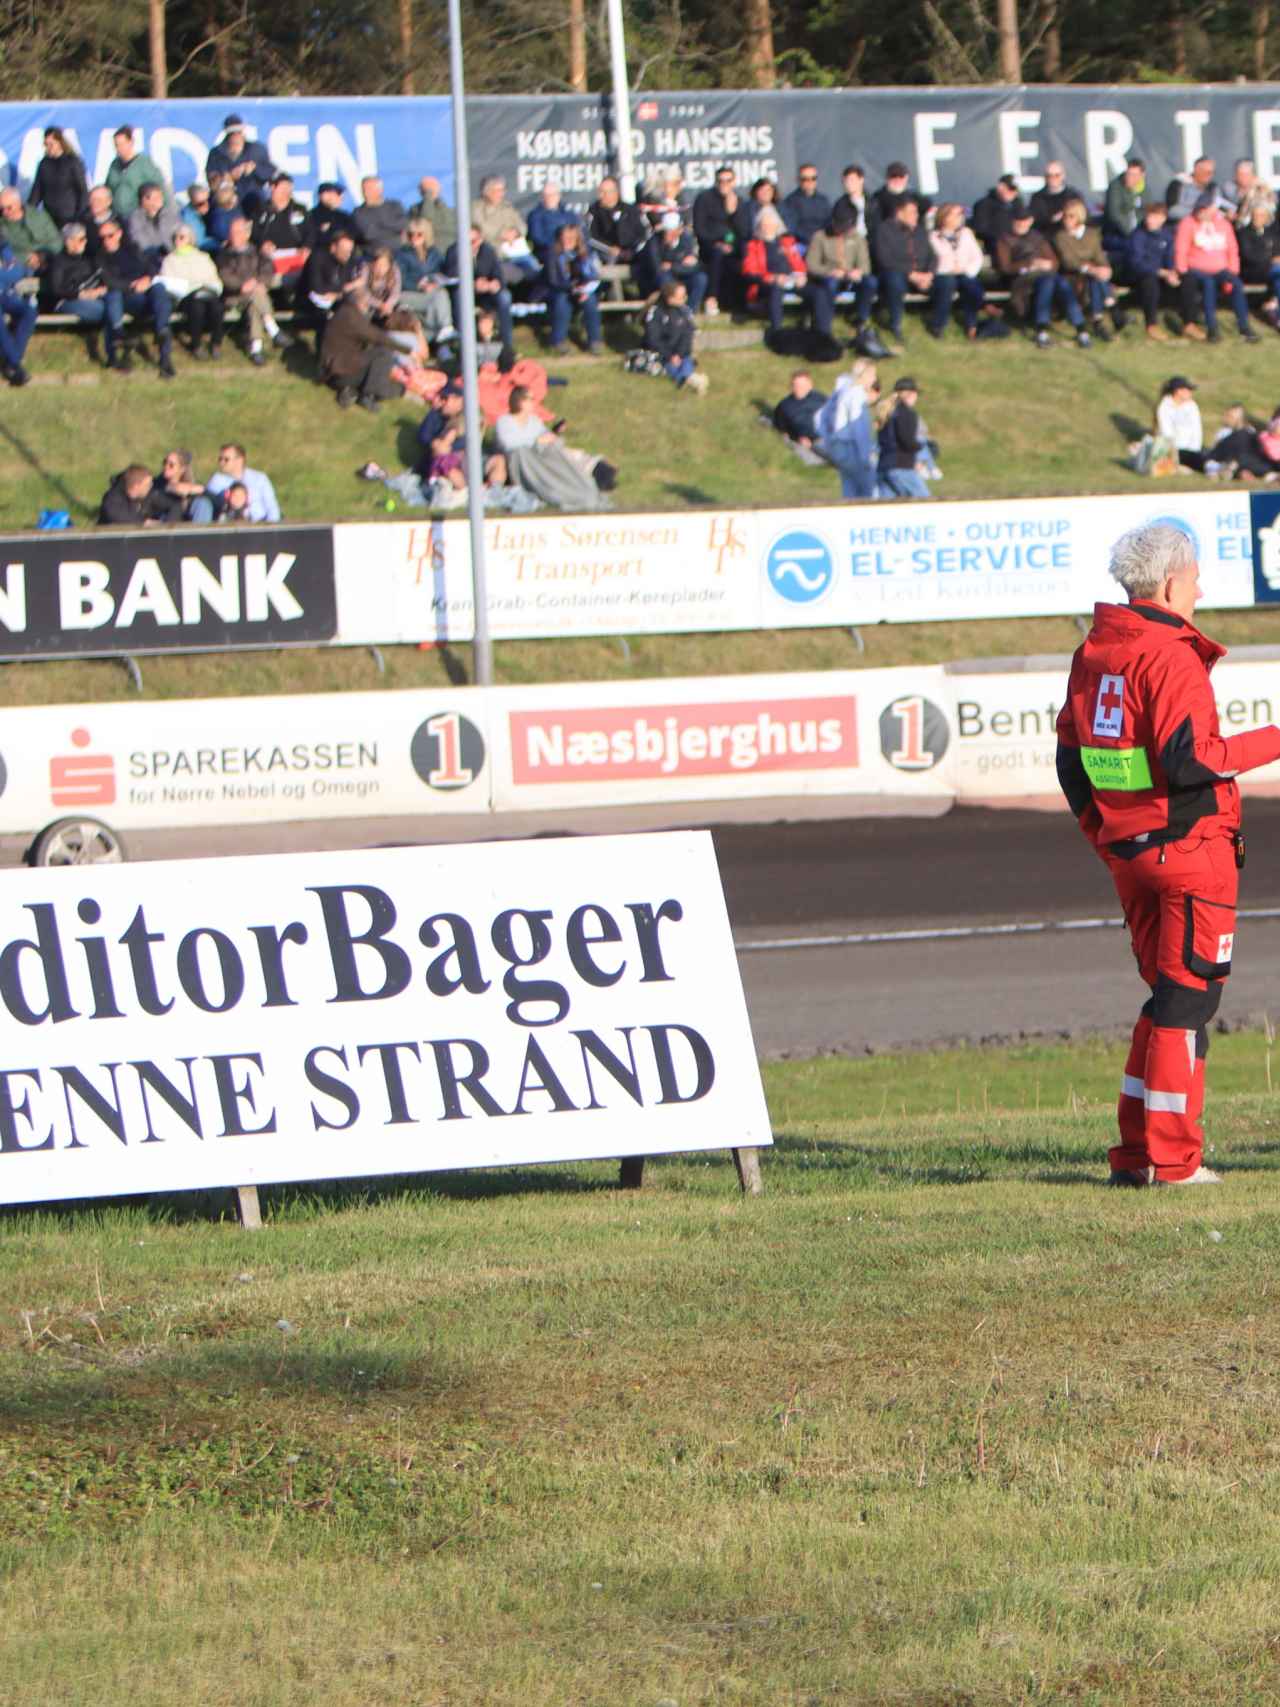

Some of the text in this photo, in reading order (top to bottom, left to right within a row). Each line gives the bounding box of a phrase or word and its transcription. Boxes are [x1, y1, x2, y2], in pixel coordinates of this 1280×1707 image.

[654, 125, 774, 157] HANSENS
[559, 522, 680, 549] Sørensen
[850, 520, 1072, 545] HENNE OUTRUP
[511, 553, 644, 586] Transport
[58, 552, 304, 630] BANK
[891, 696, 934, 768] 1
[957, 701, 1057, 738] Bent
[129, 740, 380, 778] SPAREKASSEN
[427, 711, 472, 786] 1
[526, 713, 843, 772] Næsbjerghus
[129, 779, 380, 805] for Nørre Nebel og Omegn
[0, 884, 683, 1027] ditorBager
[0, 1023, 717, 1154] ENNE STRAND
